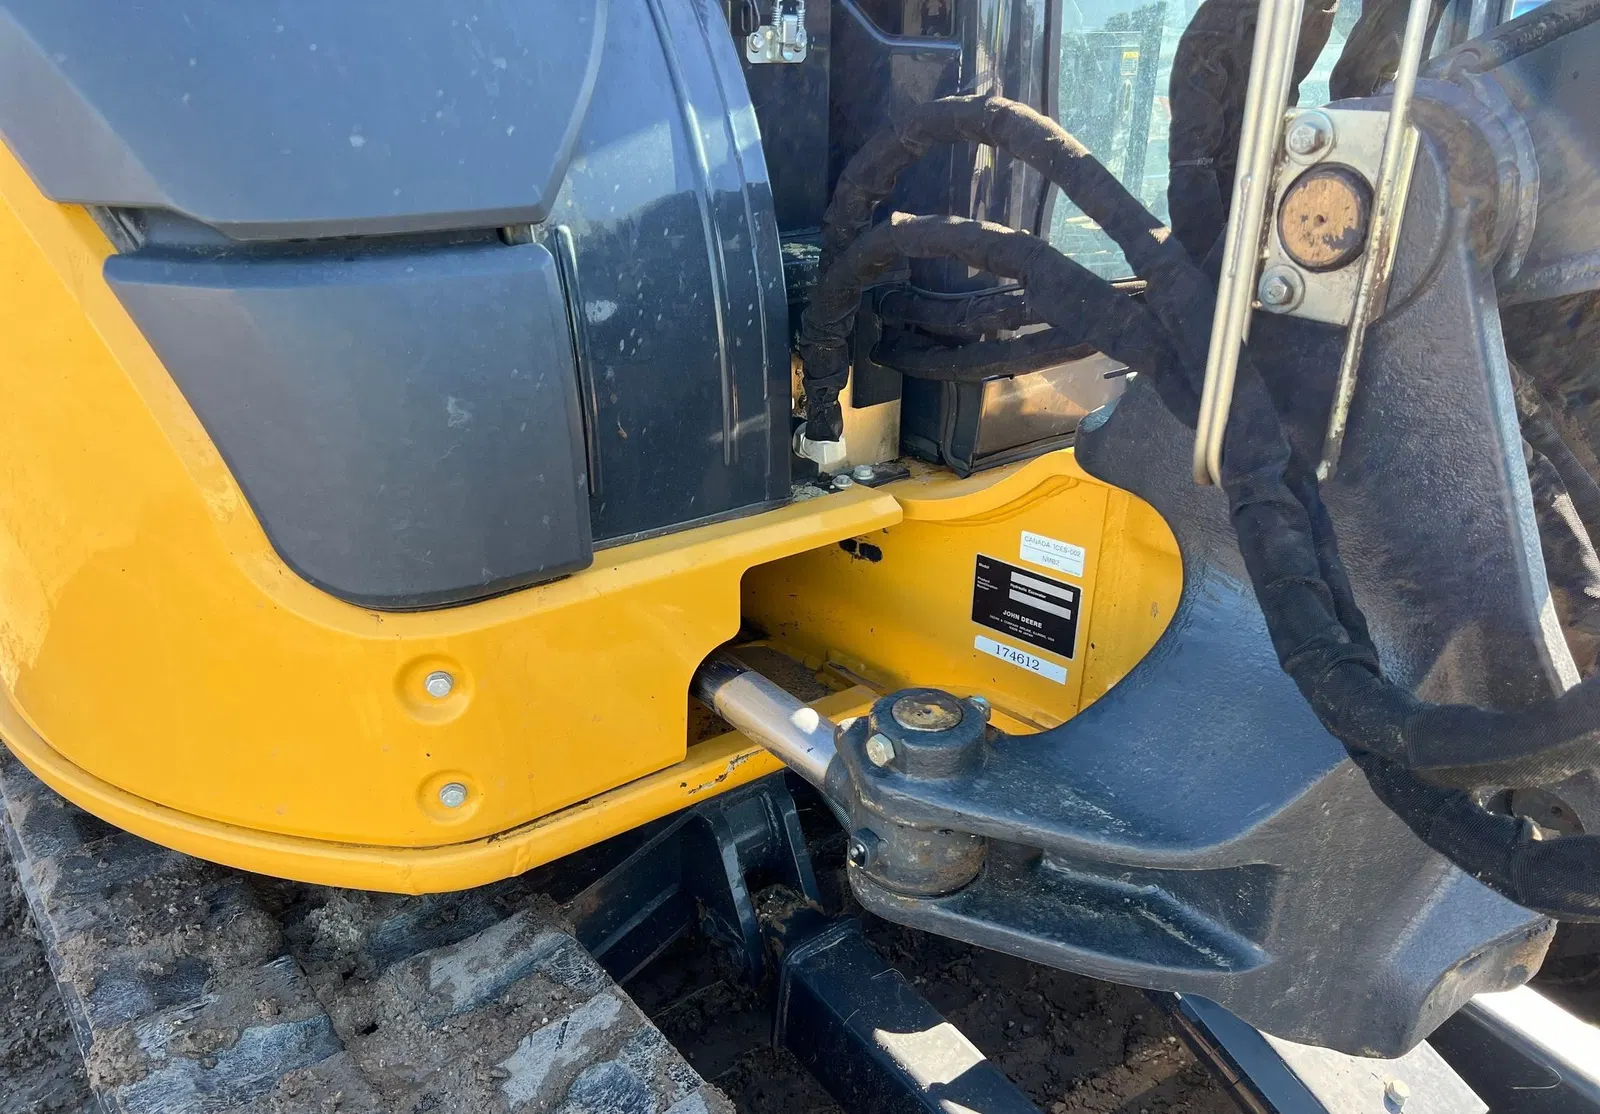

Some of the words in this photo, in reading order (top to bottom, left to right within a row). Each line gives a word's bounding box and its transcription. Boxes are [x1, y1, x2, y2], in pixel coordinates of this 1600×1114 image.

[1024, 535, 1051, 548] CANADA
[1002, 610, 1020, 620] JOHN
[1021, 616, 1043, 629] DEERE
[996, 644, 1040, 671] 174612
